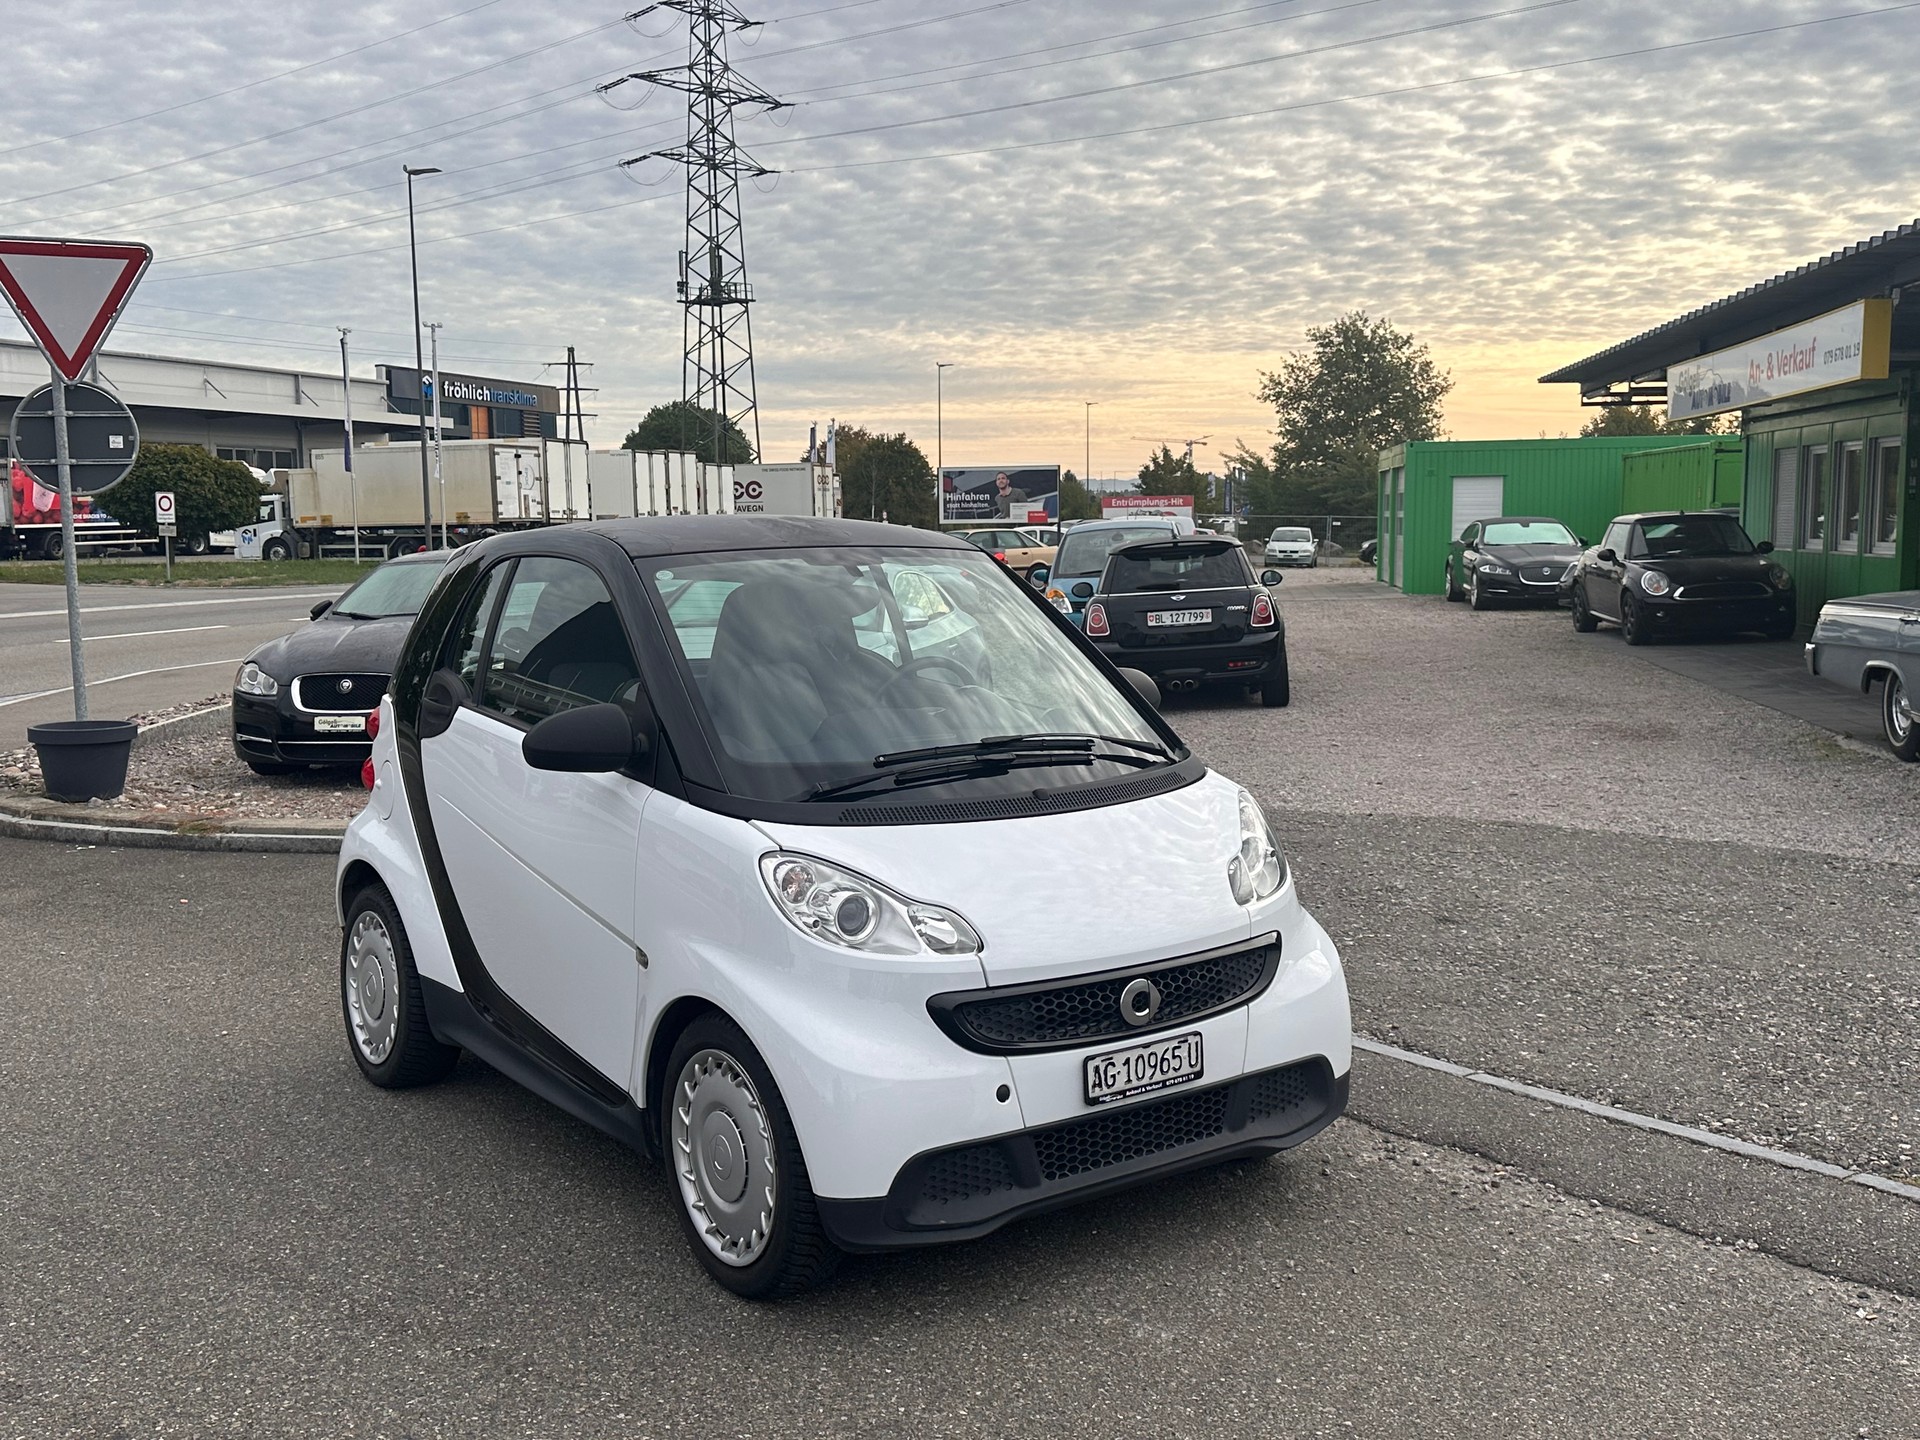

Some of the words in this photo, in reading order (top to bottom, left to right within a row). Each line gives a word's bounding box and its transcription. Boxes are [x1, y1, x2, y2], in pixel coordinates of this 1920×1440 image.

[1749, 359, 1764, 384] An-
[1766, 352, 1775, 381] &
[1776, 336, 1817, 378] Verkauf
[1823, 350, 1834, 366] 079
[1834, 347, 1845, 363] 678
[1845, 344, 1852, 360] 01
[1853, 341, 1861, 357] 19
[946, 492, 990, 502] Hinfahren
[735, 504, 764, 512] AVEGN
[1154, 613, 1167, 624] BL
[1169, 611, 1204, 623] 127799
